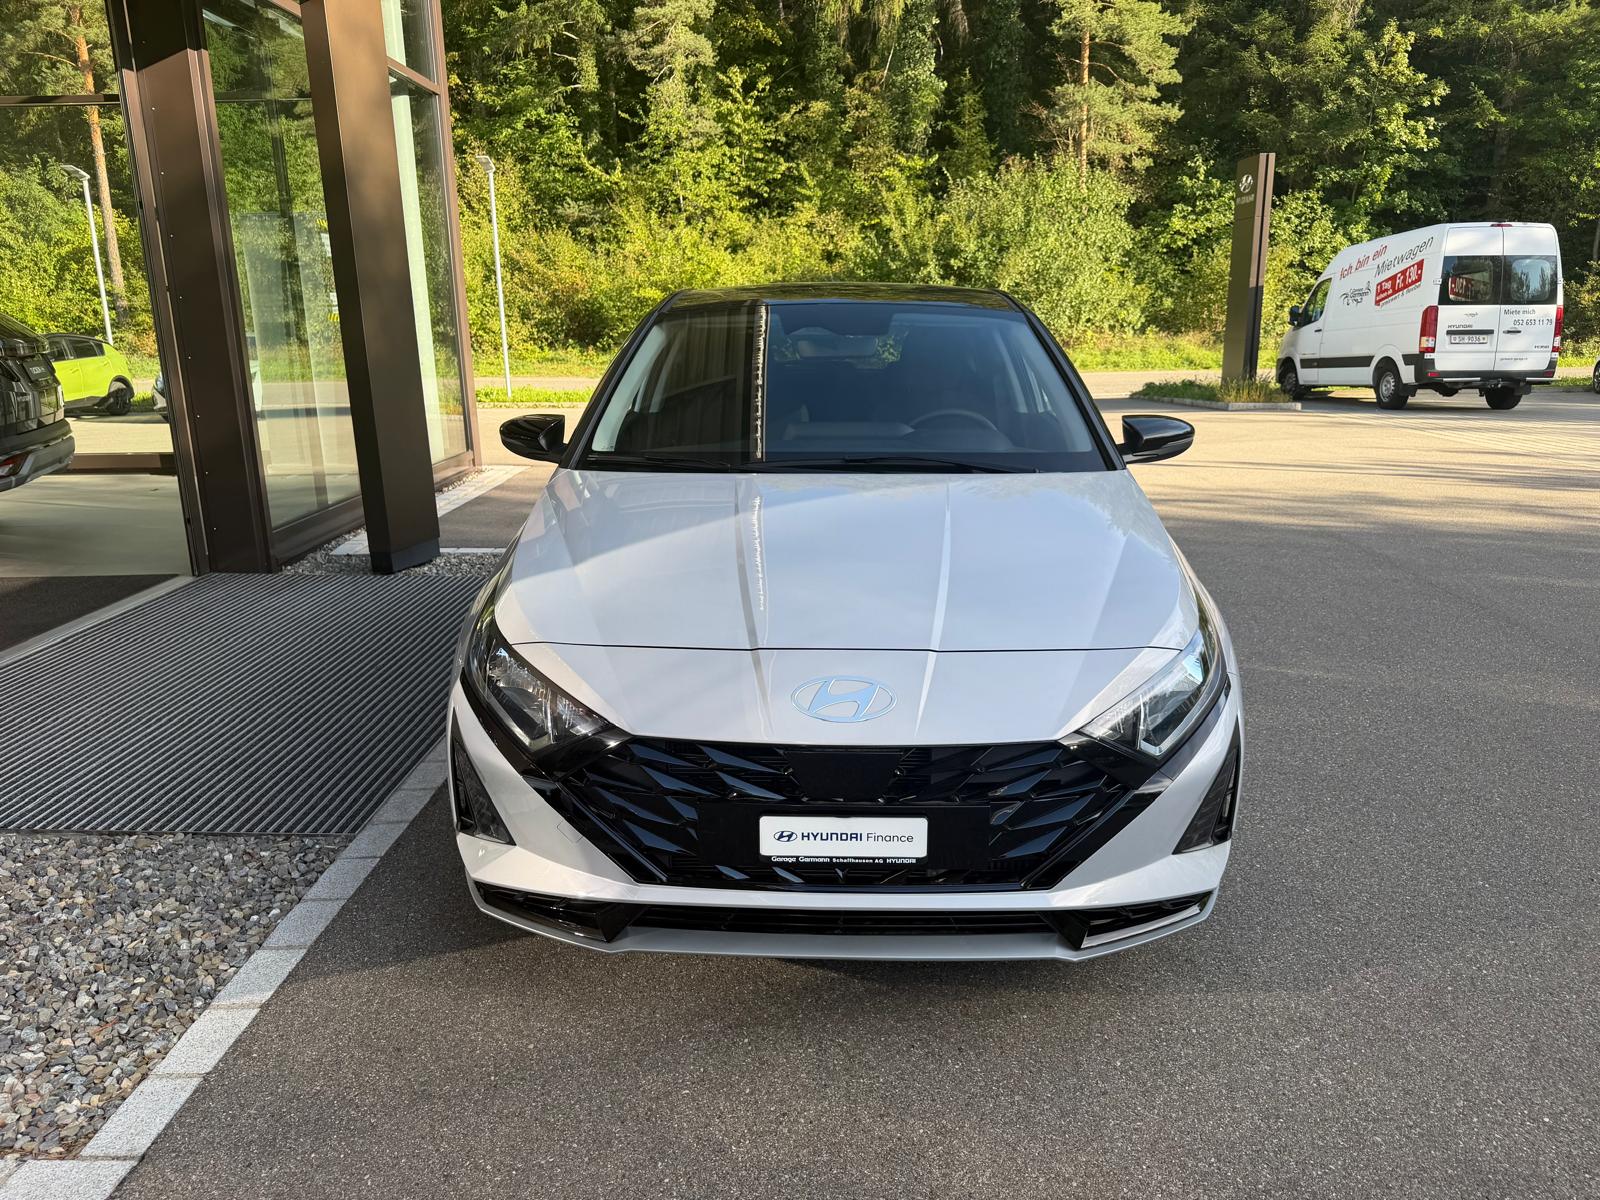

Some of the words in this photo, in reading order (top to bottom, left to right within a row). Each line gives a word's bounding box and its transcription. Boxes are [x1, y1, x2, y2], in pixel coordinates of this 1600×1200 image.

[1340, 263, 1353, 280] Ich
[1355, 254, 1370, 271] bin
[1372, 243, 1388, 261] ein
[1374, 236, 1434, 278] Mietwagen
[1382, 280, 1392, 290] Tag
[1395, 272, 1404, 290] Fr.
[801, 832, 862, 842] HYUNDAI
[866, 832, 914, 843] Finance
